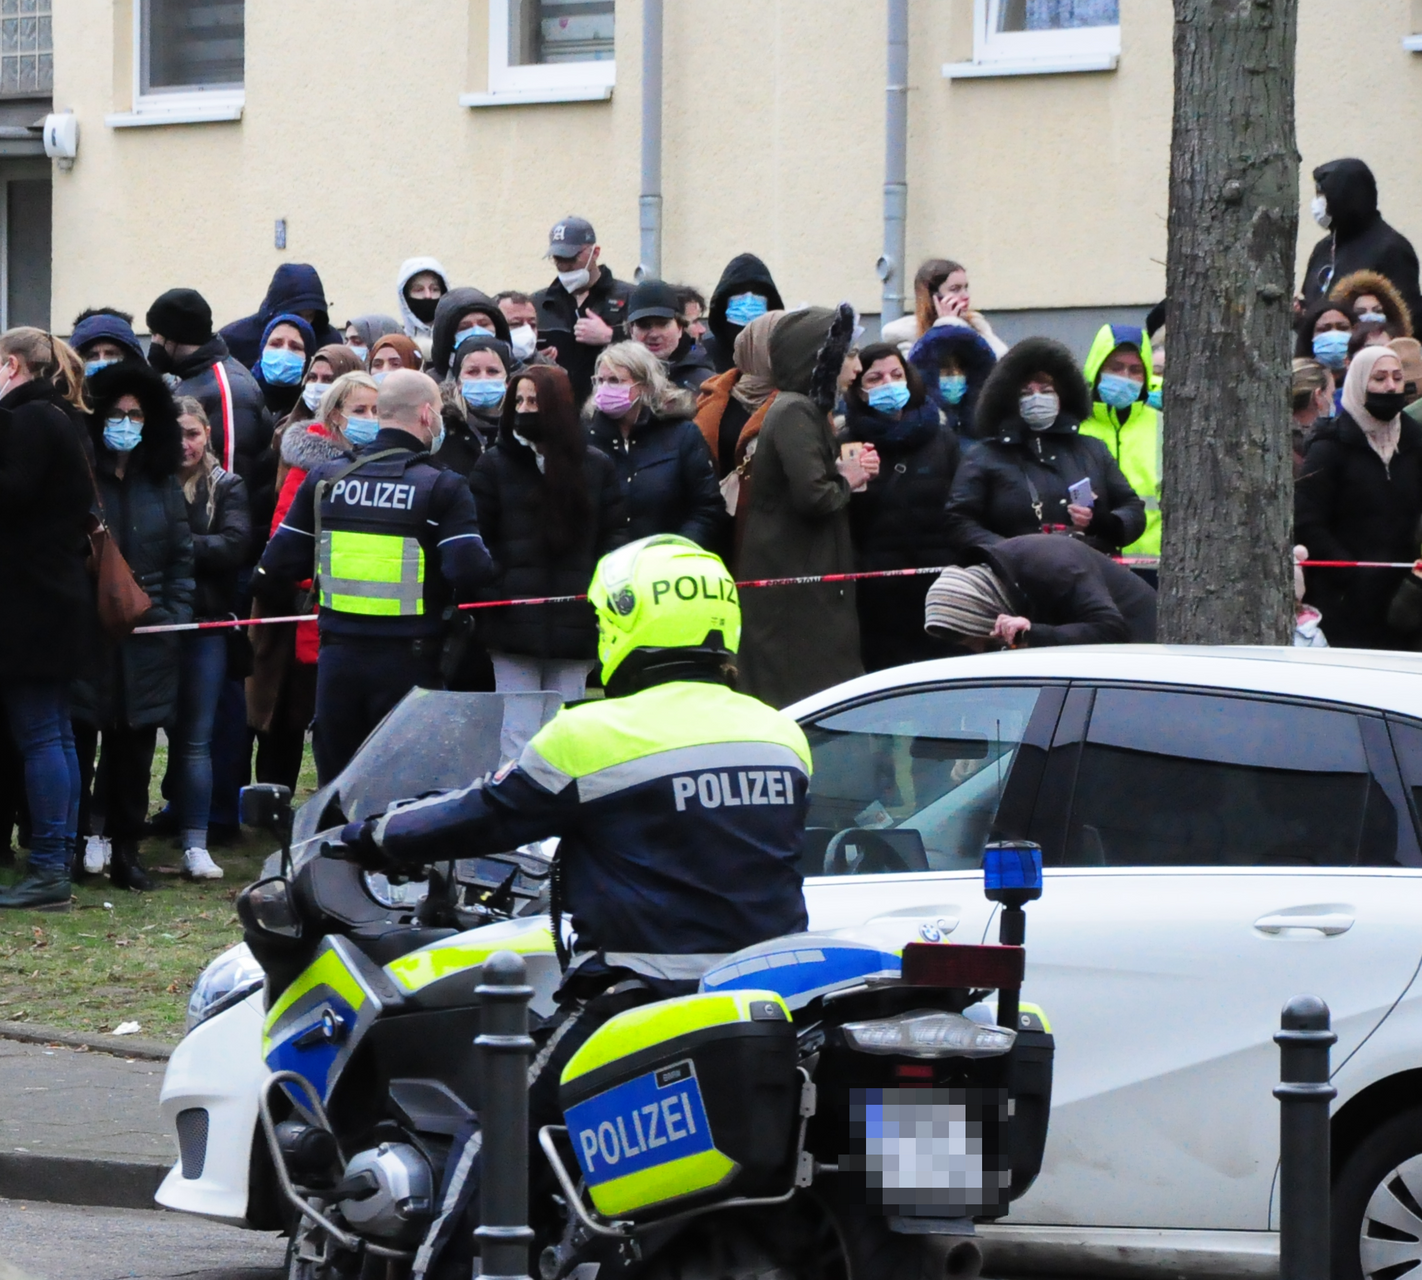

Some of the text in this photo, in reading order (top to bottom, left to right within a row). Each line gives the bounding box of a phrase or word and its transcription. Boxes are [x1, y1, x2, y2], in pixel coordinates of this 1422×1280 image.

[330, 479, 416, 510] POLIZEI
[651, 575, 738, 606] POLIZ
[672, 770, 794, 811] POLIZEI
[579, 1091, 697, 1173] POLIZEI
